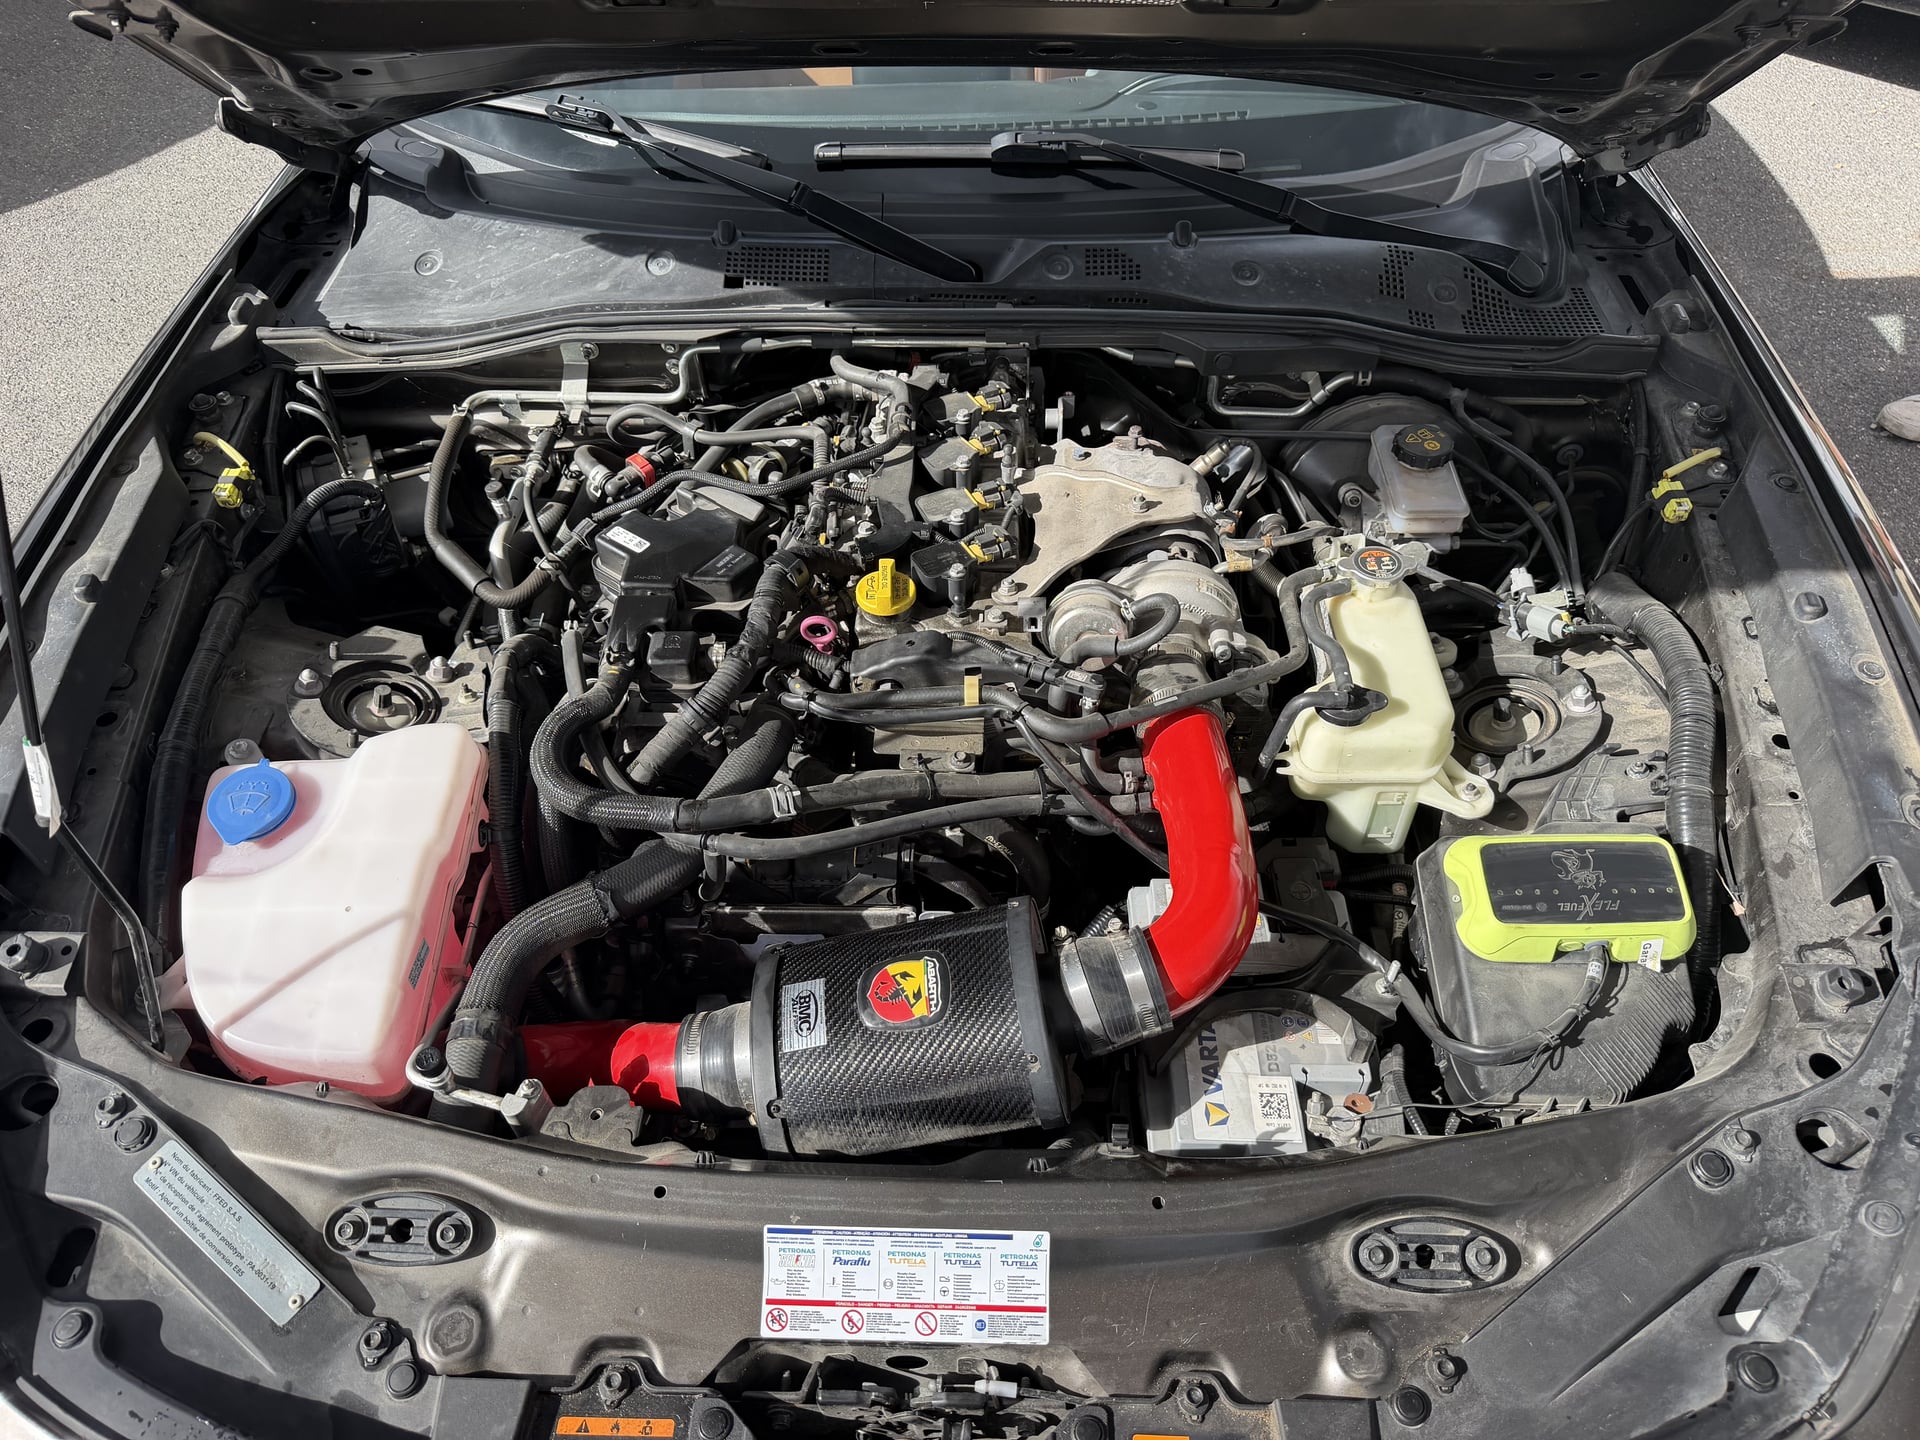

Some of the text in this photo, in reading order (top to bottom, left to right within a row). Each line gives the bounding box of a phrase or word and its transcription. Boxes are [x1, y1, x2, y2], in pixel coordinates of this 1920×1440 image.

[927, 960, 937, 1012] ABARTH
[799, 995, 812, 1033] BMC
[168, 1166, 179, 1177] VIN
[176, 1174, 186, 1184] du
[170, 1151, 244, 1223] Nom du fabricant FFED S.A.S.
[143, 1176, 159, 1191] Motif
[157, 1191, 174, 1207] Ajout
[171, 1203, 185, 1218] d'un
[197, 1230, 207, 1240] de
[204, 1237, 235, 1267] conversion
[231, 1264, 245, 1277] E85
[158, 1174, 168, 1183] de
[187, 1202, 196, 1212] de
[217, 1234, 246, 1262] prototype
[832, 1256, 871, 1267] Paraflu
[888, 1257, 926, 1265] TUTELA
